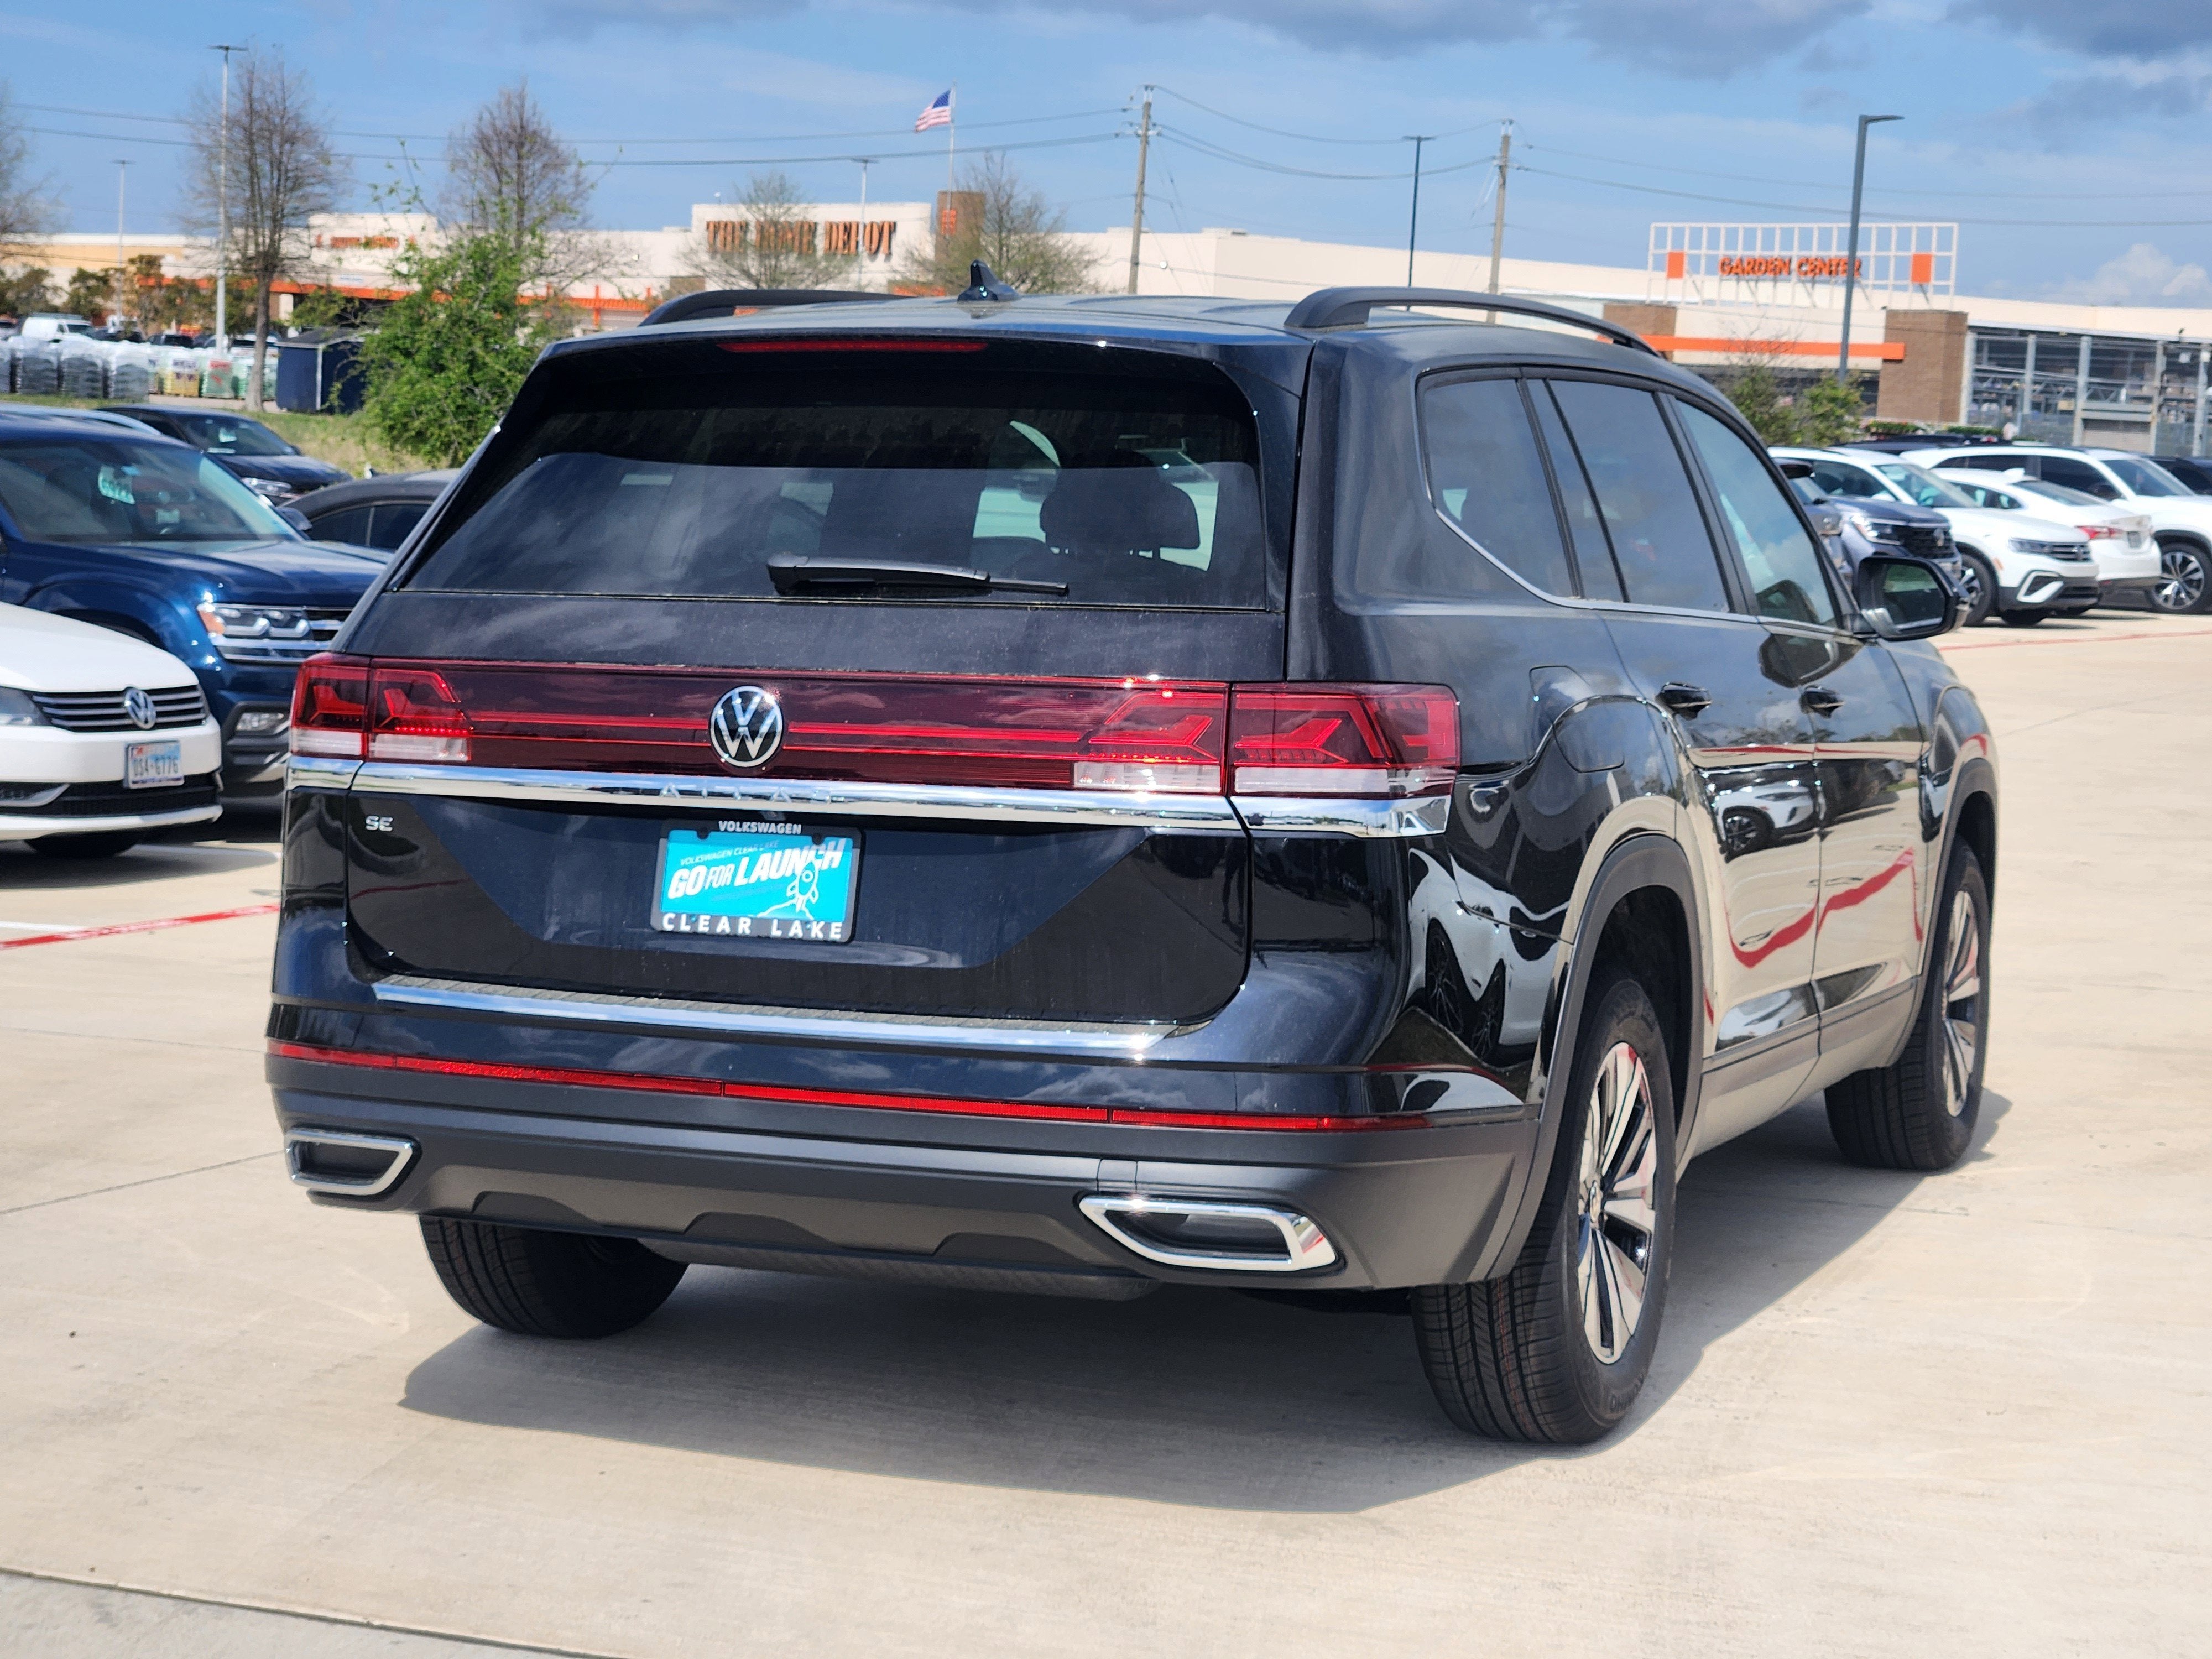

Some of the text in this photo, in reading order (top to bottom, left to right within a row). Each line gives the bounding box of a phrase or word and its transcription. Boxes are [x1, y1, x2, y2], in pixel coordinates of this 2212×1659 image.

[1719, 256, 1791, 276] GARDEN
[365, 815, 394, 832] SE
[718, 820, 802, 835] VOLKSWAGEN
[667, 864, 708, 899] GO
[705, 863, 735, 890] FOR
[734, 838, 847, 886] LAUNCH
[662, 912, 843, 939] CLEAR LAKE
